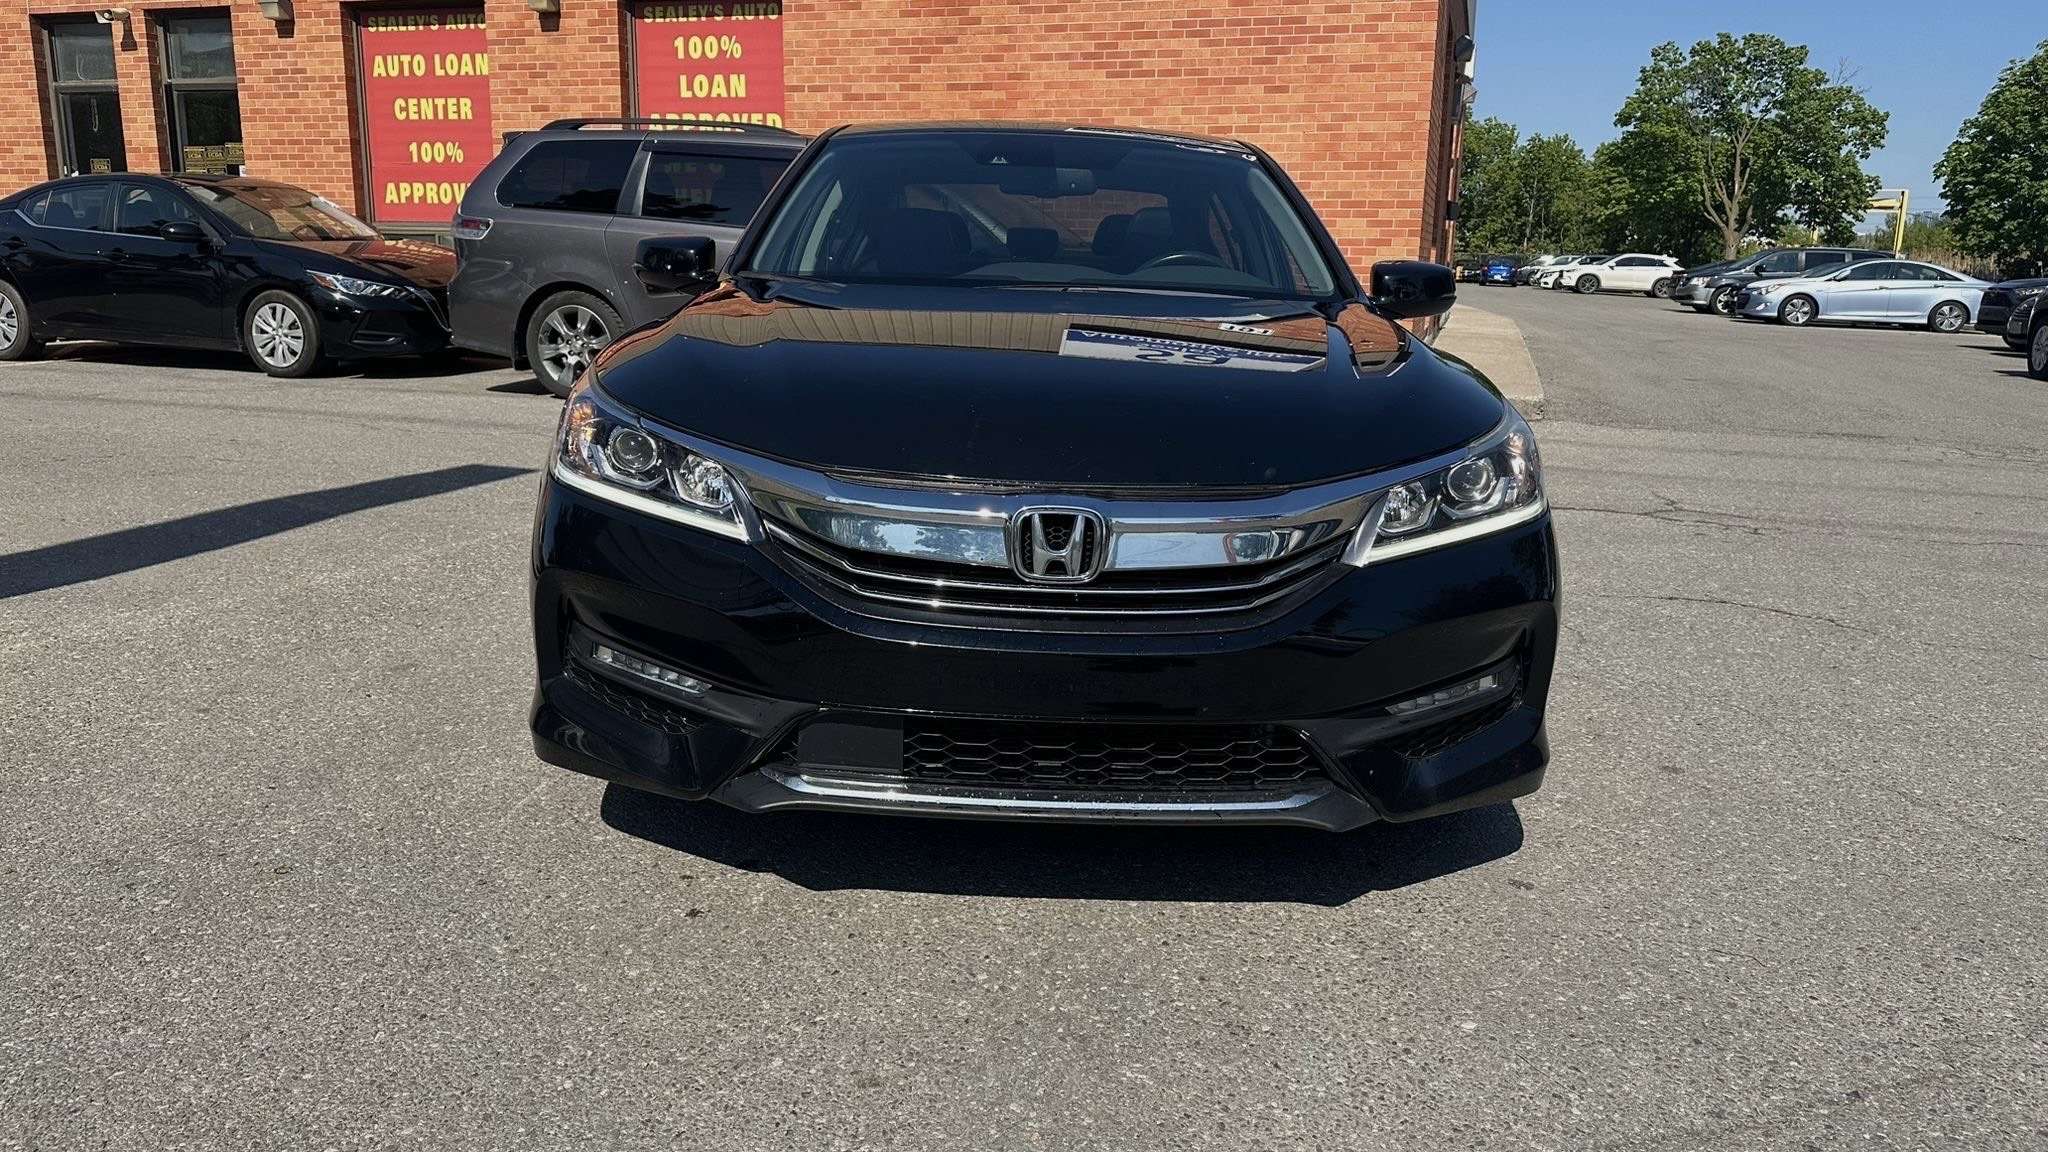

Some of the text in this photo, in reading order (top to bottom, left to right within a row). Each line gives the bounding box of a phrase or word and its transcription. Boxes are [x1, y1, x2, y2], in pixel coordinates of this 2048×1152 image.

[368, 12, 487, 33] SEALEY'S AUTO
[643, 2, 779, 24] SEALEY'S AUTO
[673, 34, 743, 60] 100%
[372, 52, 490, 78] AUTO LOAN
[679, 73, 747, 99] LOAN
[393, 97, 473, 121] CENTER
[408, 140, 465, 164] 100%
[384, 180, 471, 205] APPROV
